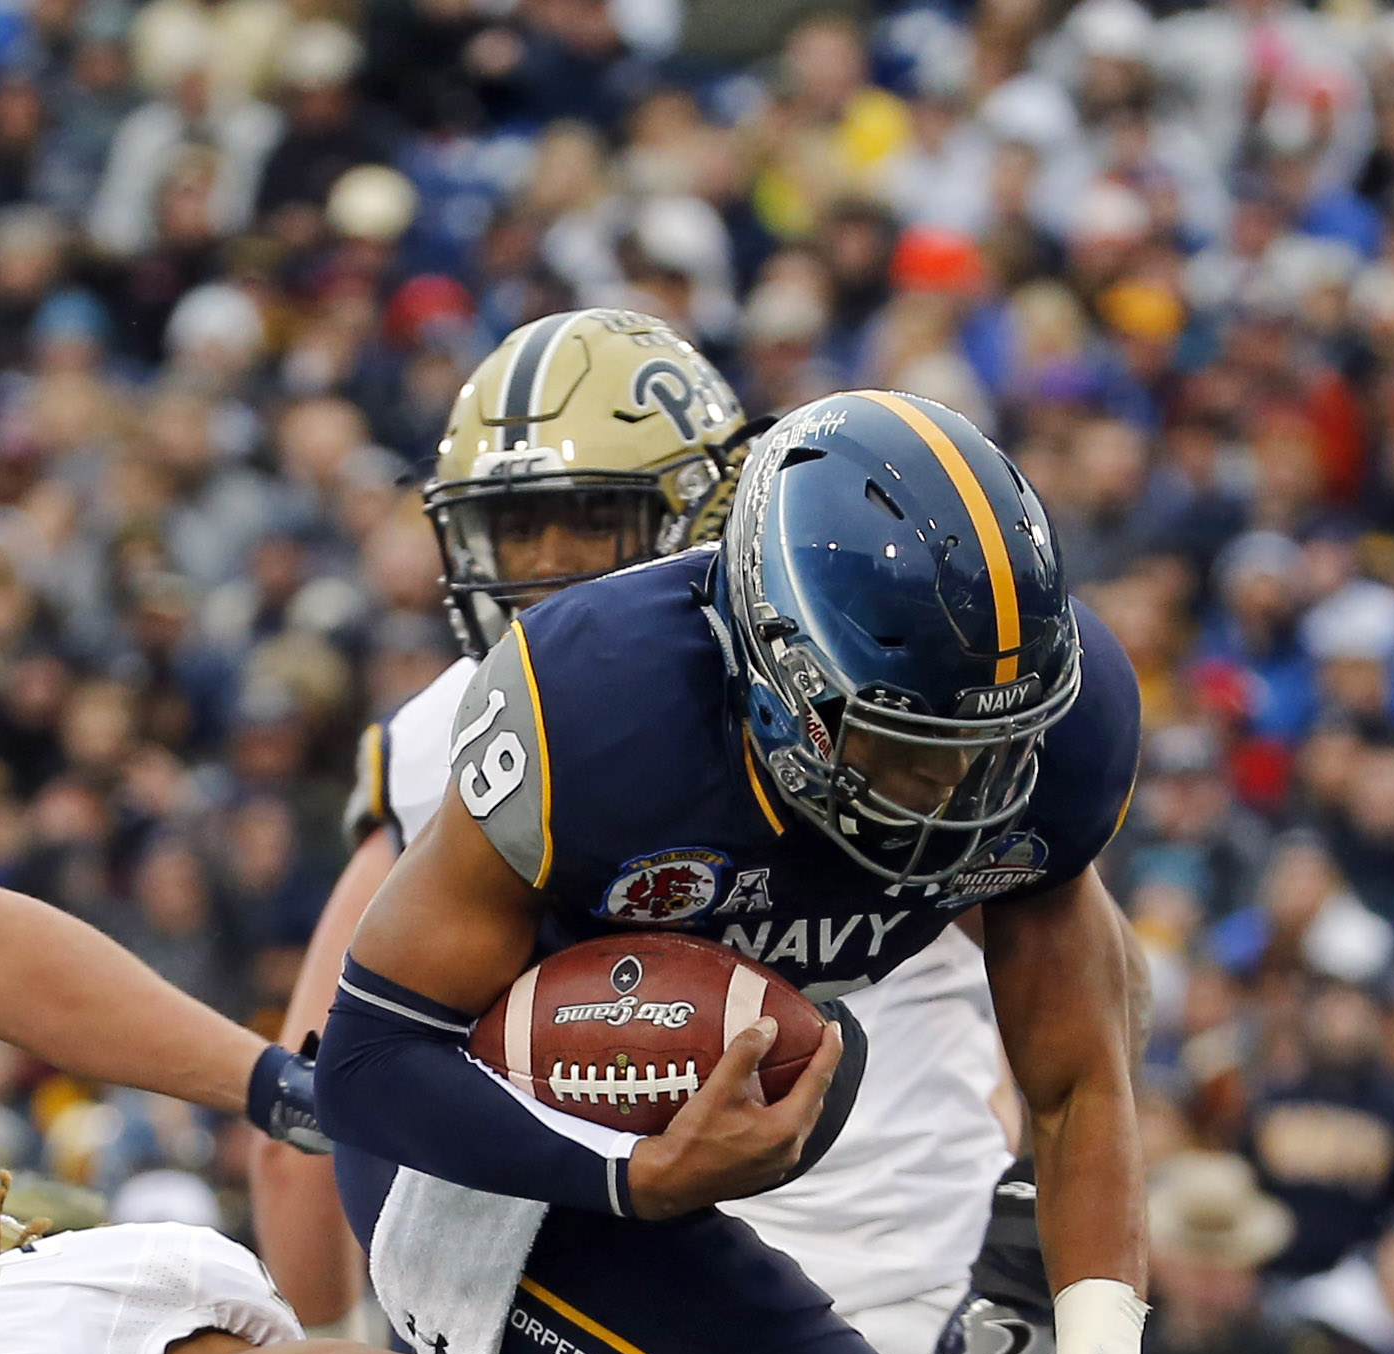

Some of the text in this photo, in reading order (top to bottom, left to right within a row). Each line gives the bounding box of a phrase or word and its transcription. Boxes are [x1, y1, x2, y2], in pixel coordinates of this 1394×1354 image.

[976, 684, 1029, 714] NAVY
[450, 688, 529, 820] 19
[952, 872, 1040, 886] MILITARY
[720, 909, 912, 964] NAVY
[553, 995, 697, 1030] Big Game
